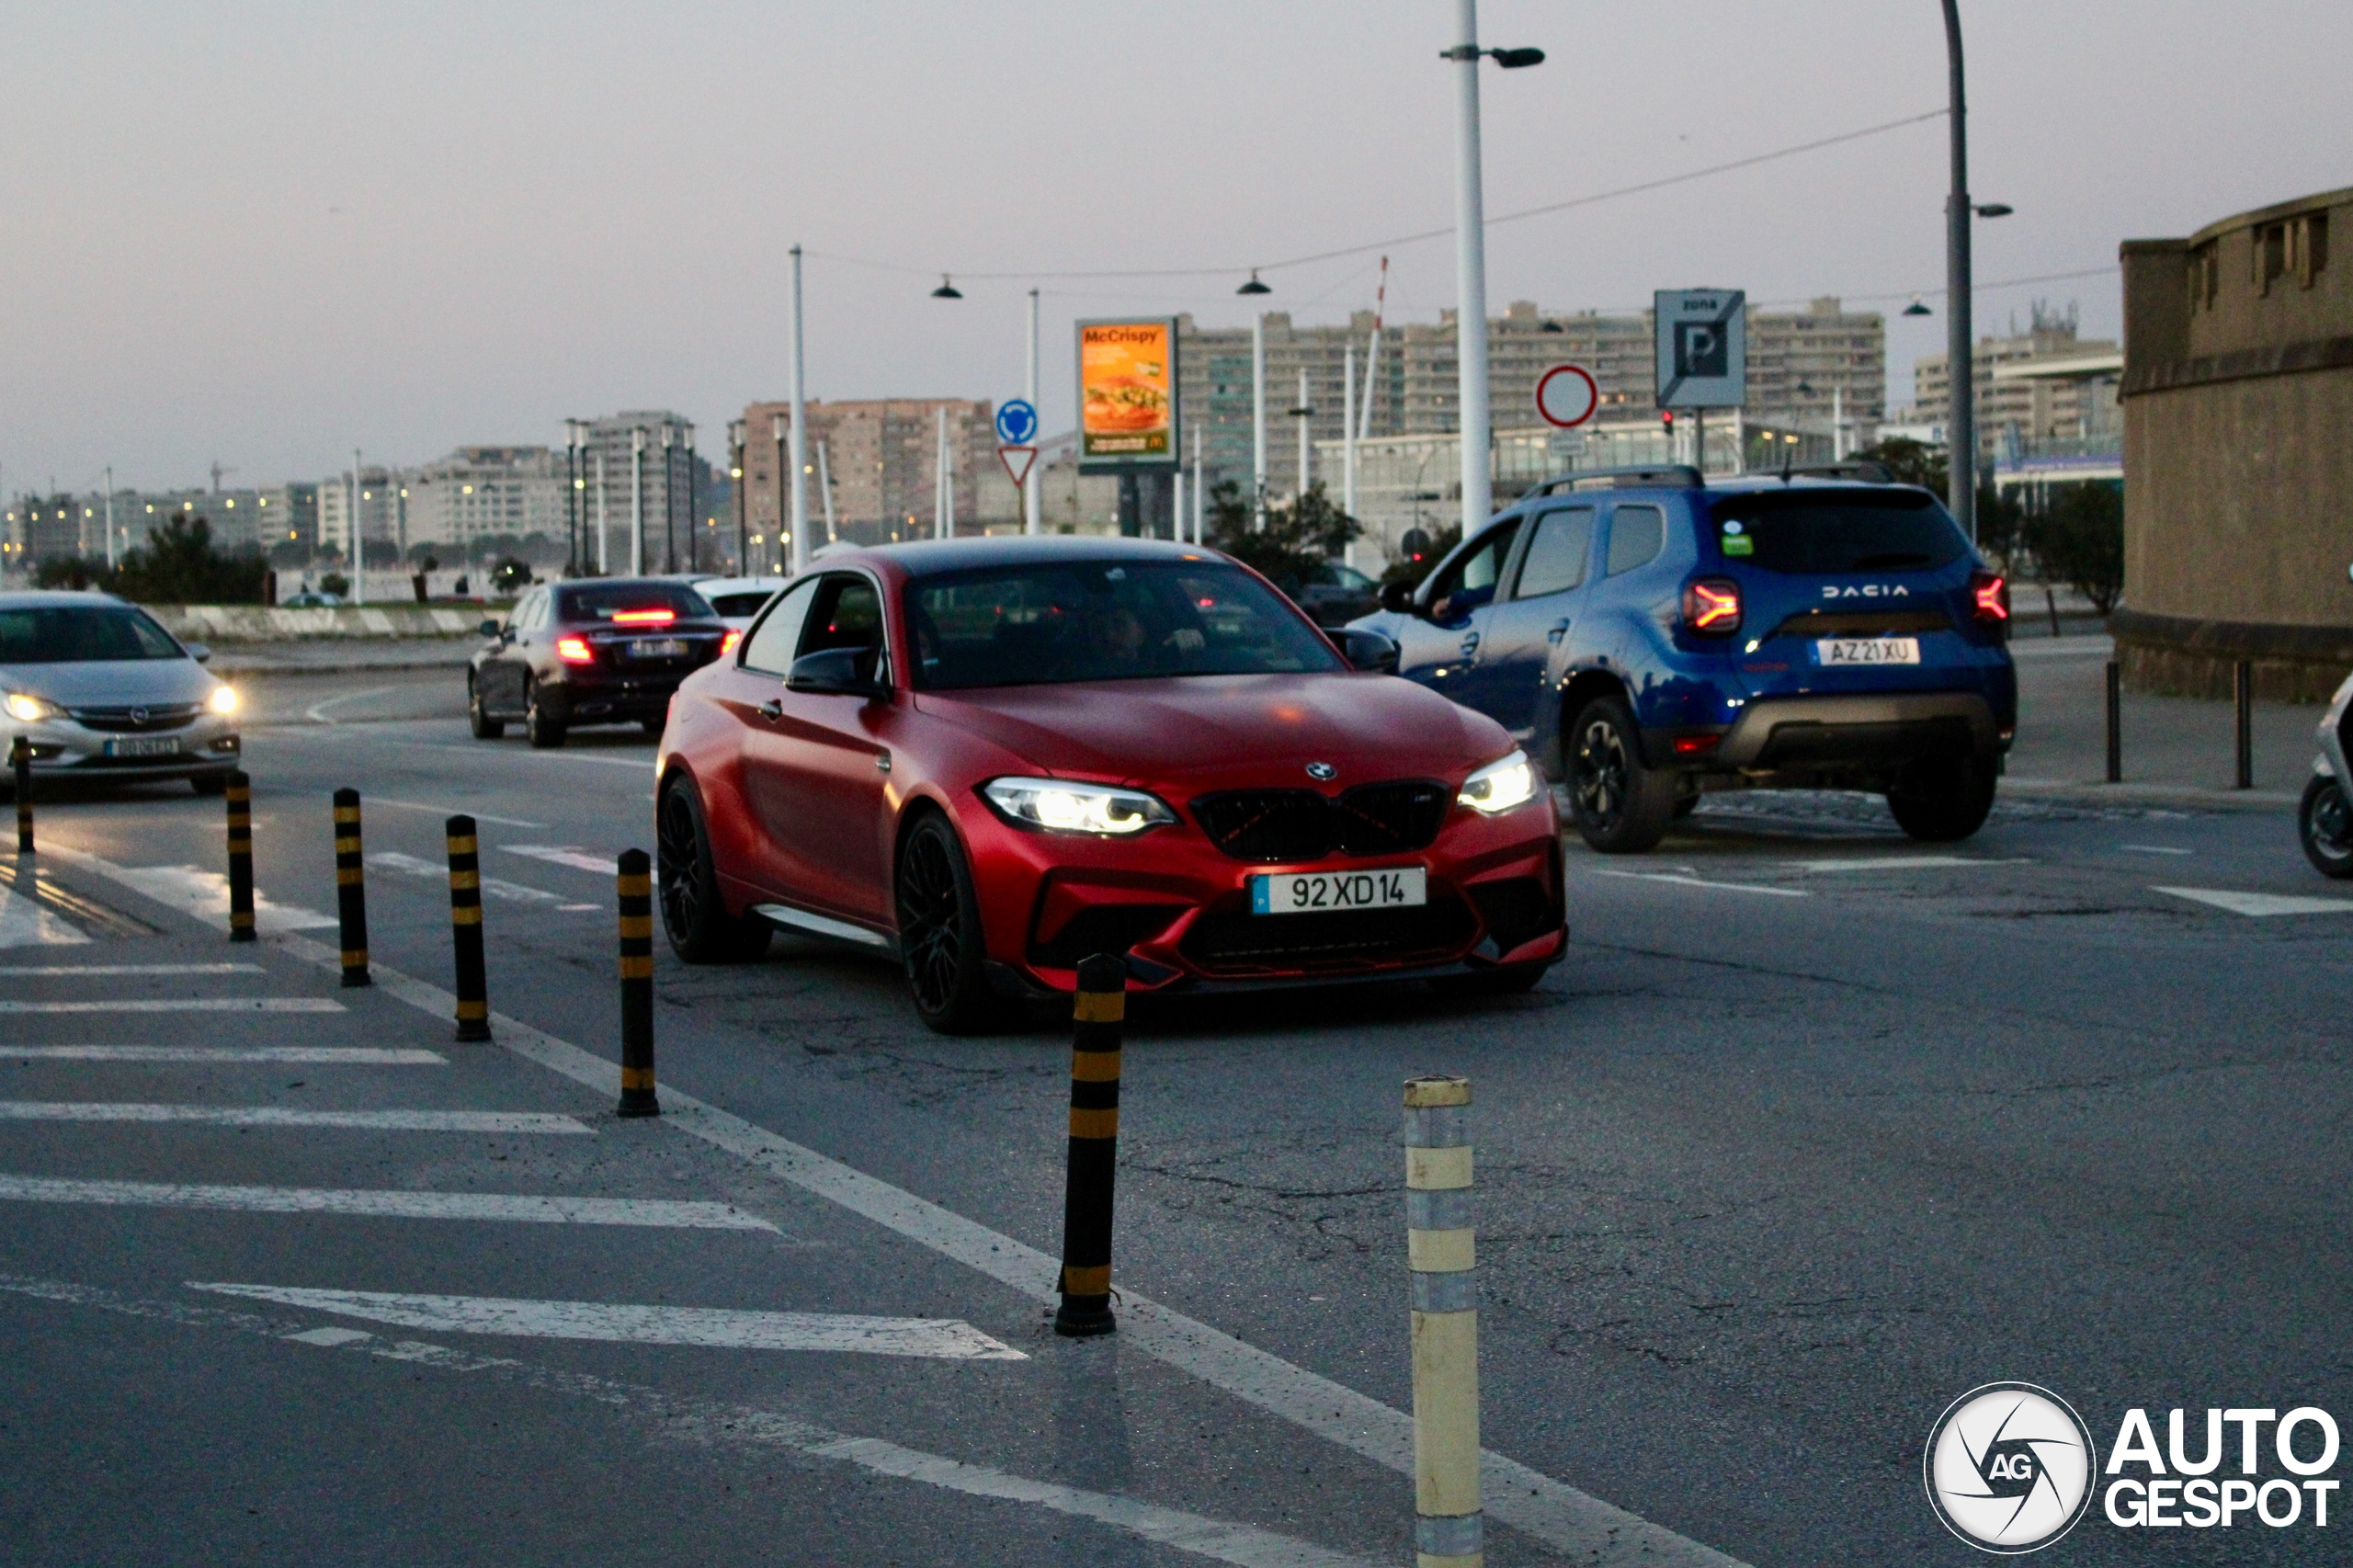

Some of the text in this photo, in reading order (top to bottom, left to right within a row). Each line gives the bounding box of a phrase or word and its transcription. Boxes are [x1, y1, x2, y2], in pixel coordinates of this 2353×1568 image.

[1683, 300, 1717, 311] zona
[1085, 327, 1158, 345] McCrispy
[1686, 326, 1717, 373] P
[1822, 585, 1909, 598] DACIA
